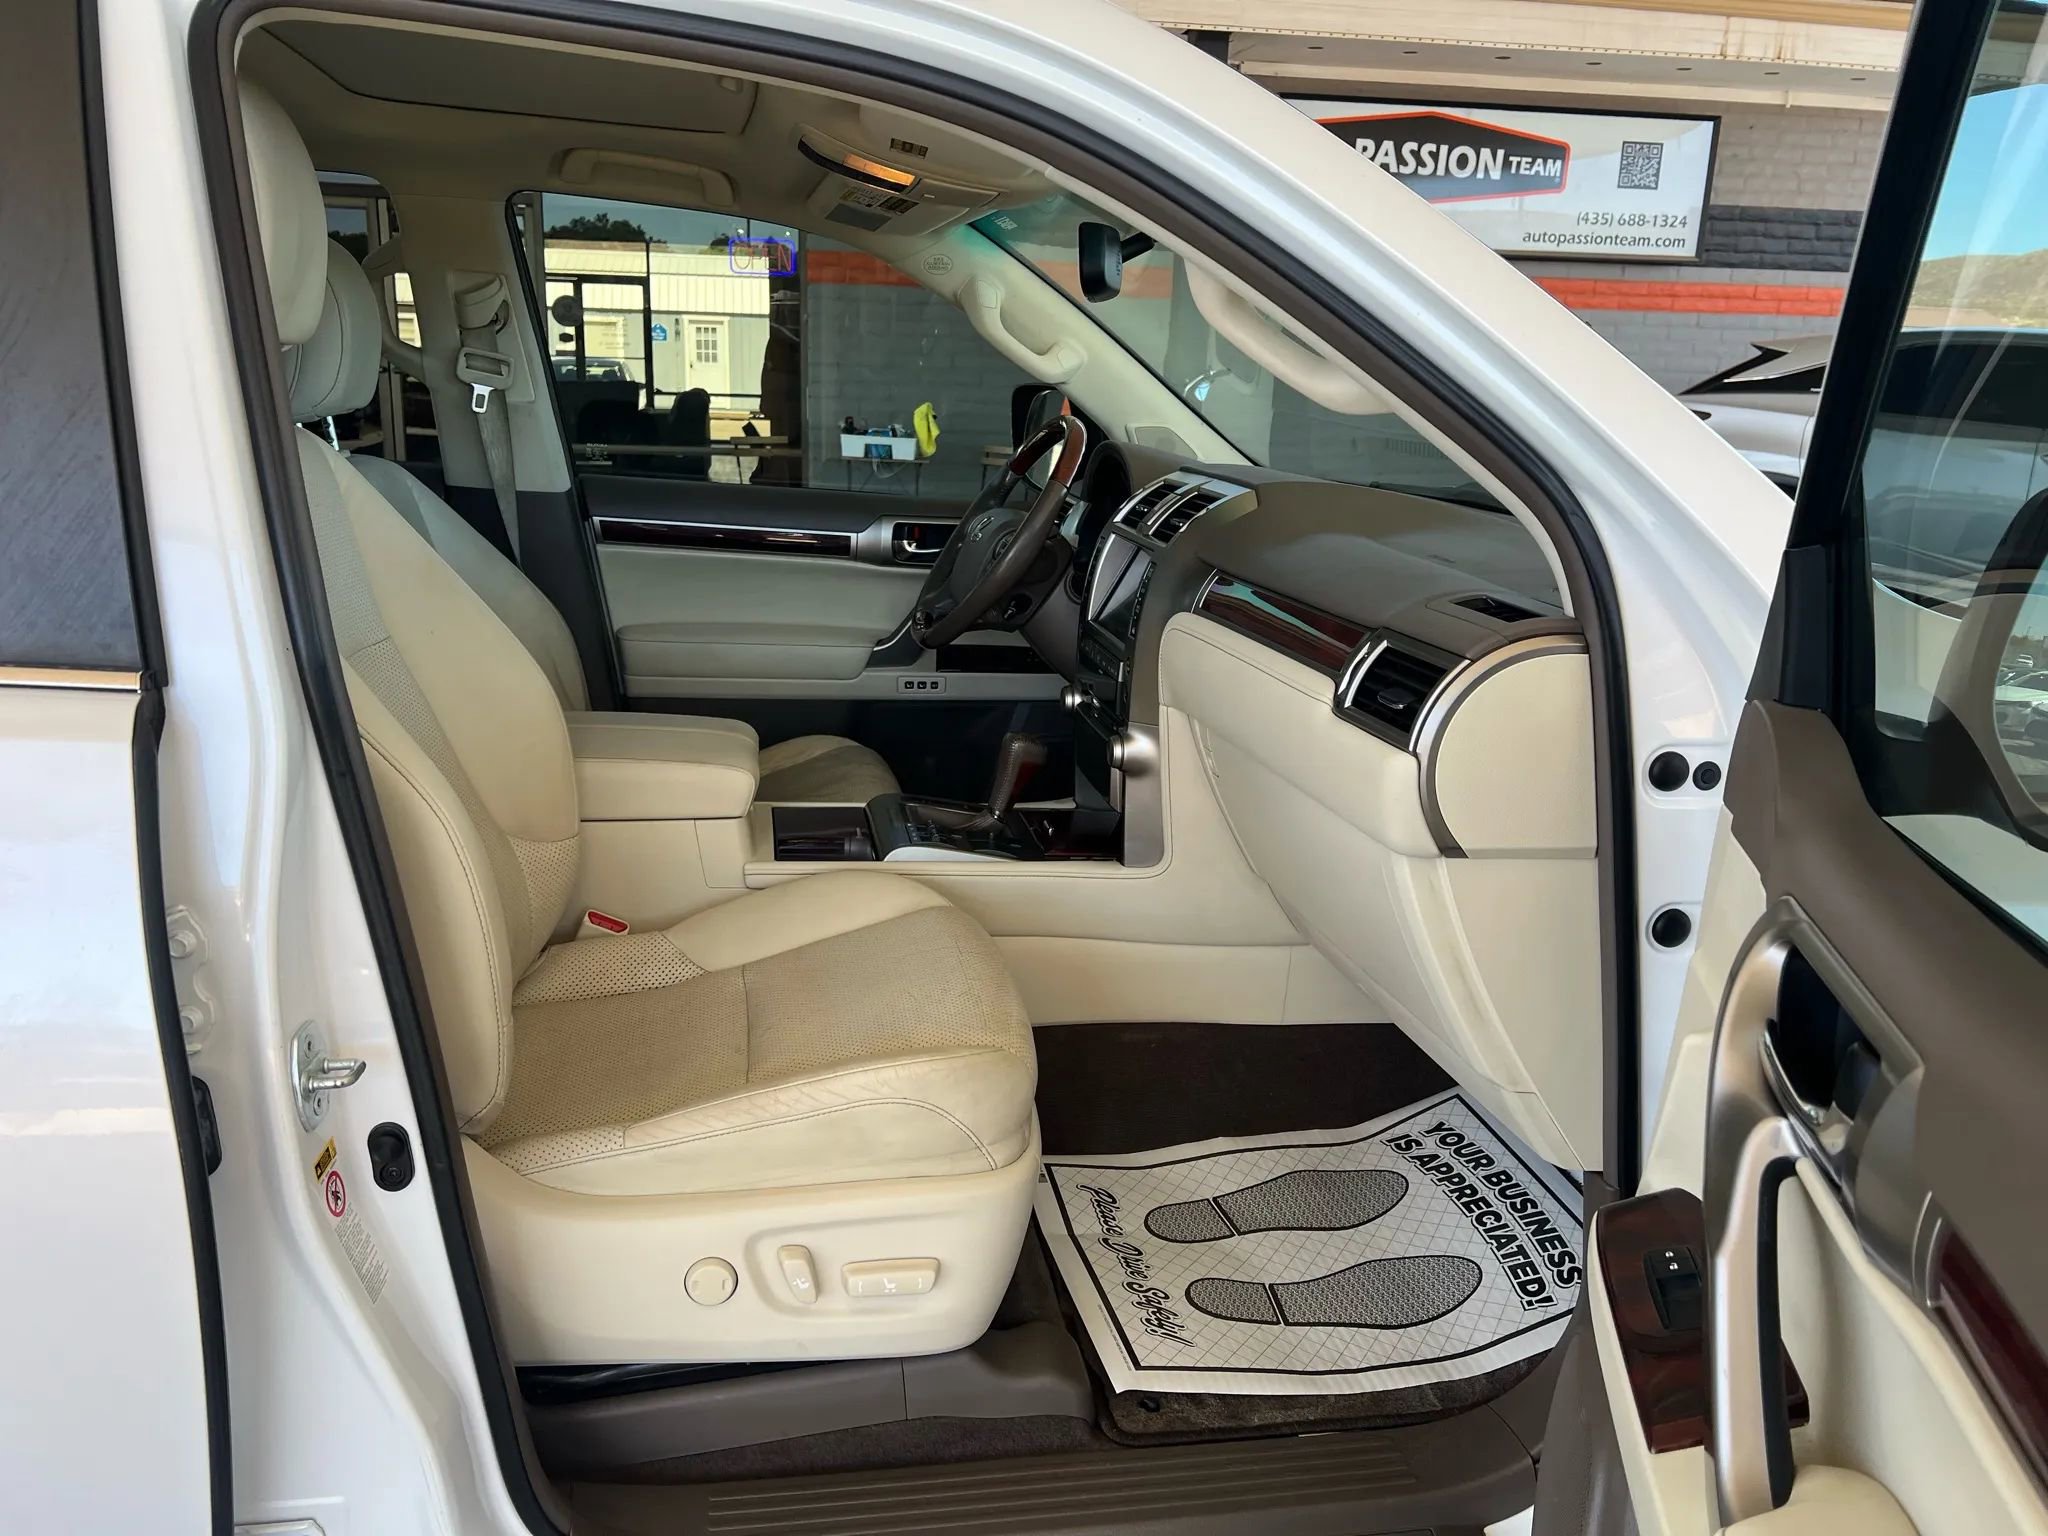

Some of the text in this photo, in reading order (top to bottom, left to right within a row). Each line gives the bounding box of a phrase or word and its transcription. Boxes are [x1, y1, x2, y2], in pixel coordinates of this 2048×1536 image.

[1355, 138, 1563, 180] PASSION TEAM
[1522, 231, 1686, 248] autopassionteam.com
[1577, 211, 1688, 228] (435) 688-1324
[734, 242, 792, 272] OPEN
[1077, 1184, 1125, 1238] Please
[1383, 1133, 1556, 1310] IS APPRECIATED!
[1420, 1121, 1582, 1287] YOUR BUSINESS
[1099, 1237, 1152, 1281] Drive
[1122, 1281, 1197, 1347] Safely!
